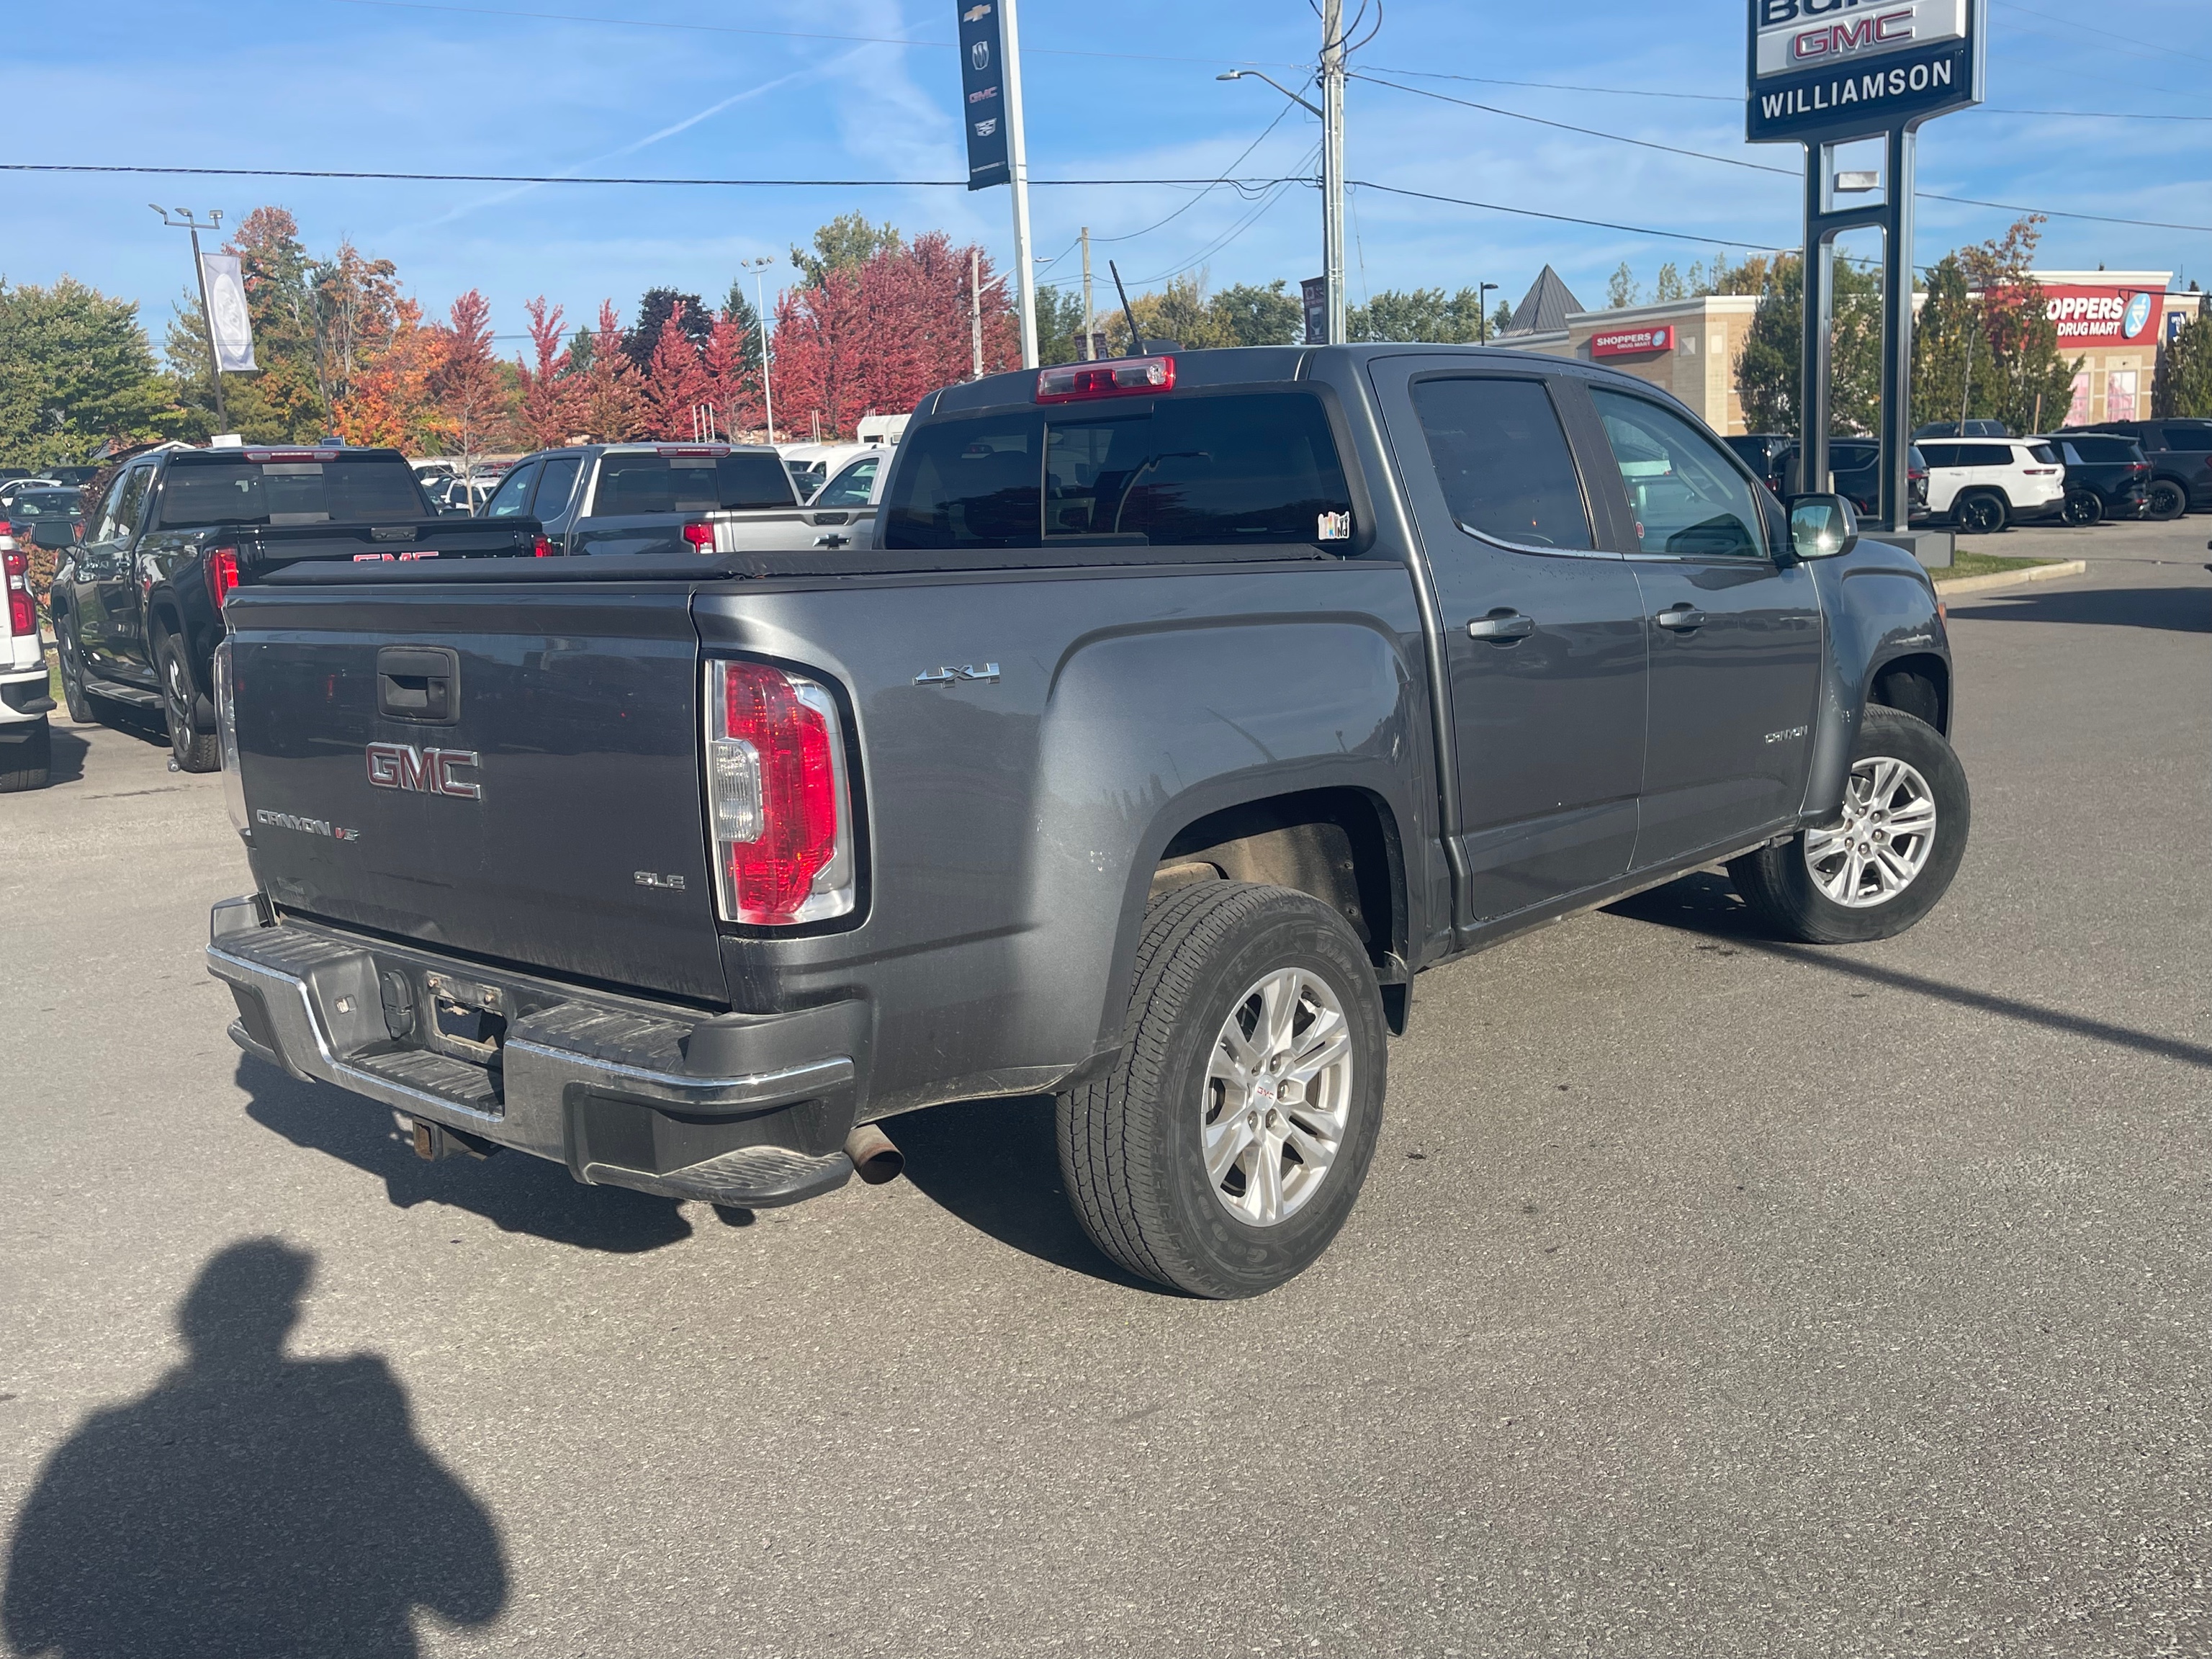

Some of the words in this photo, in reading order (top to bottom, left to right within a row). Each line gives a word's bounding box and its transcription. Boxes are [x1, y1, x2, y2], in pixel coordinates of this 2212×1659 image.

[1794, 6, 1916, 60] GMC
[968, 86, 998, 103] GMC
[1761, 59, 1951, 119] WILLIAMSON
[2045, 296, 2124, 321] OPPERS
[2056, 323, 2088, 336] DRUG
[2089, 321, 2121, 336] MART
[1596, 333, 1652, 346] SHOPPERS
[1764, 724, 1808, 744] CANYON
[366, 742, 482, 800] GMC
[256, 809, 331, 837] CANYON
[634, 871, 685, 890] SLE
[1256, 1086, 1274, 1100] GMC
